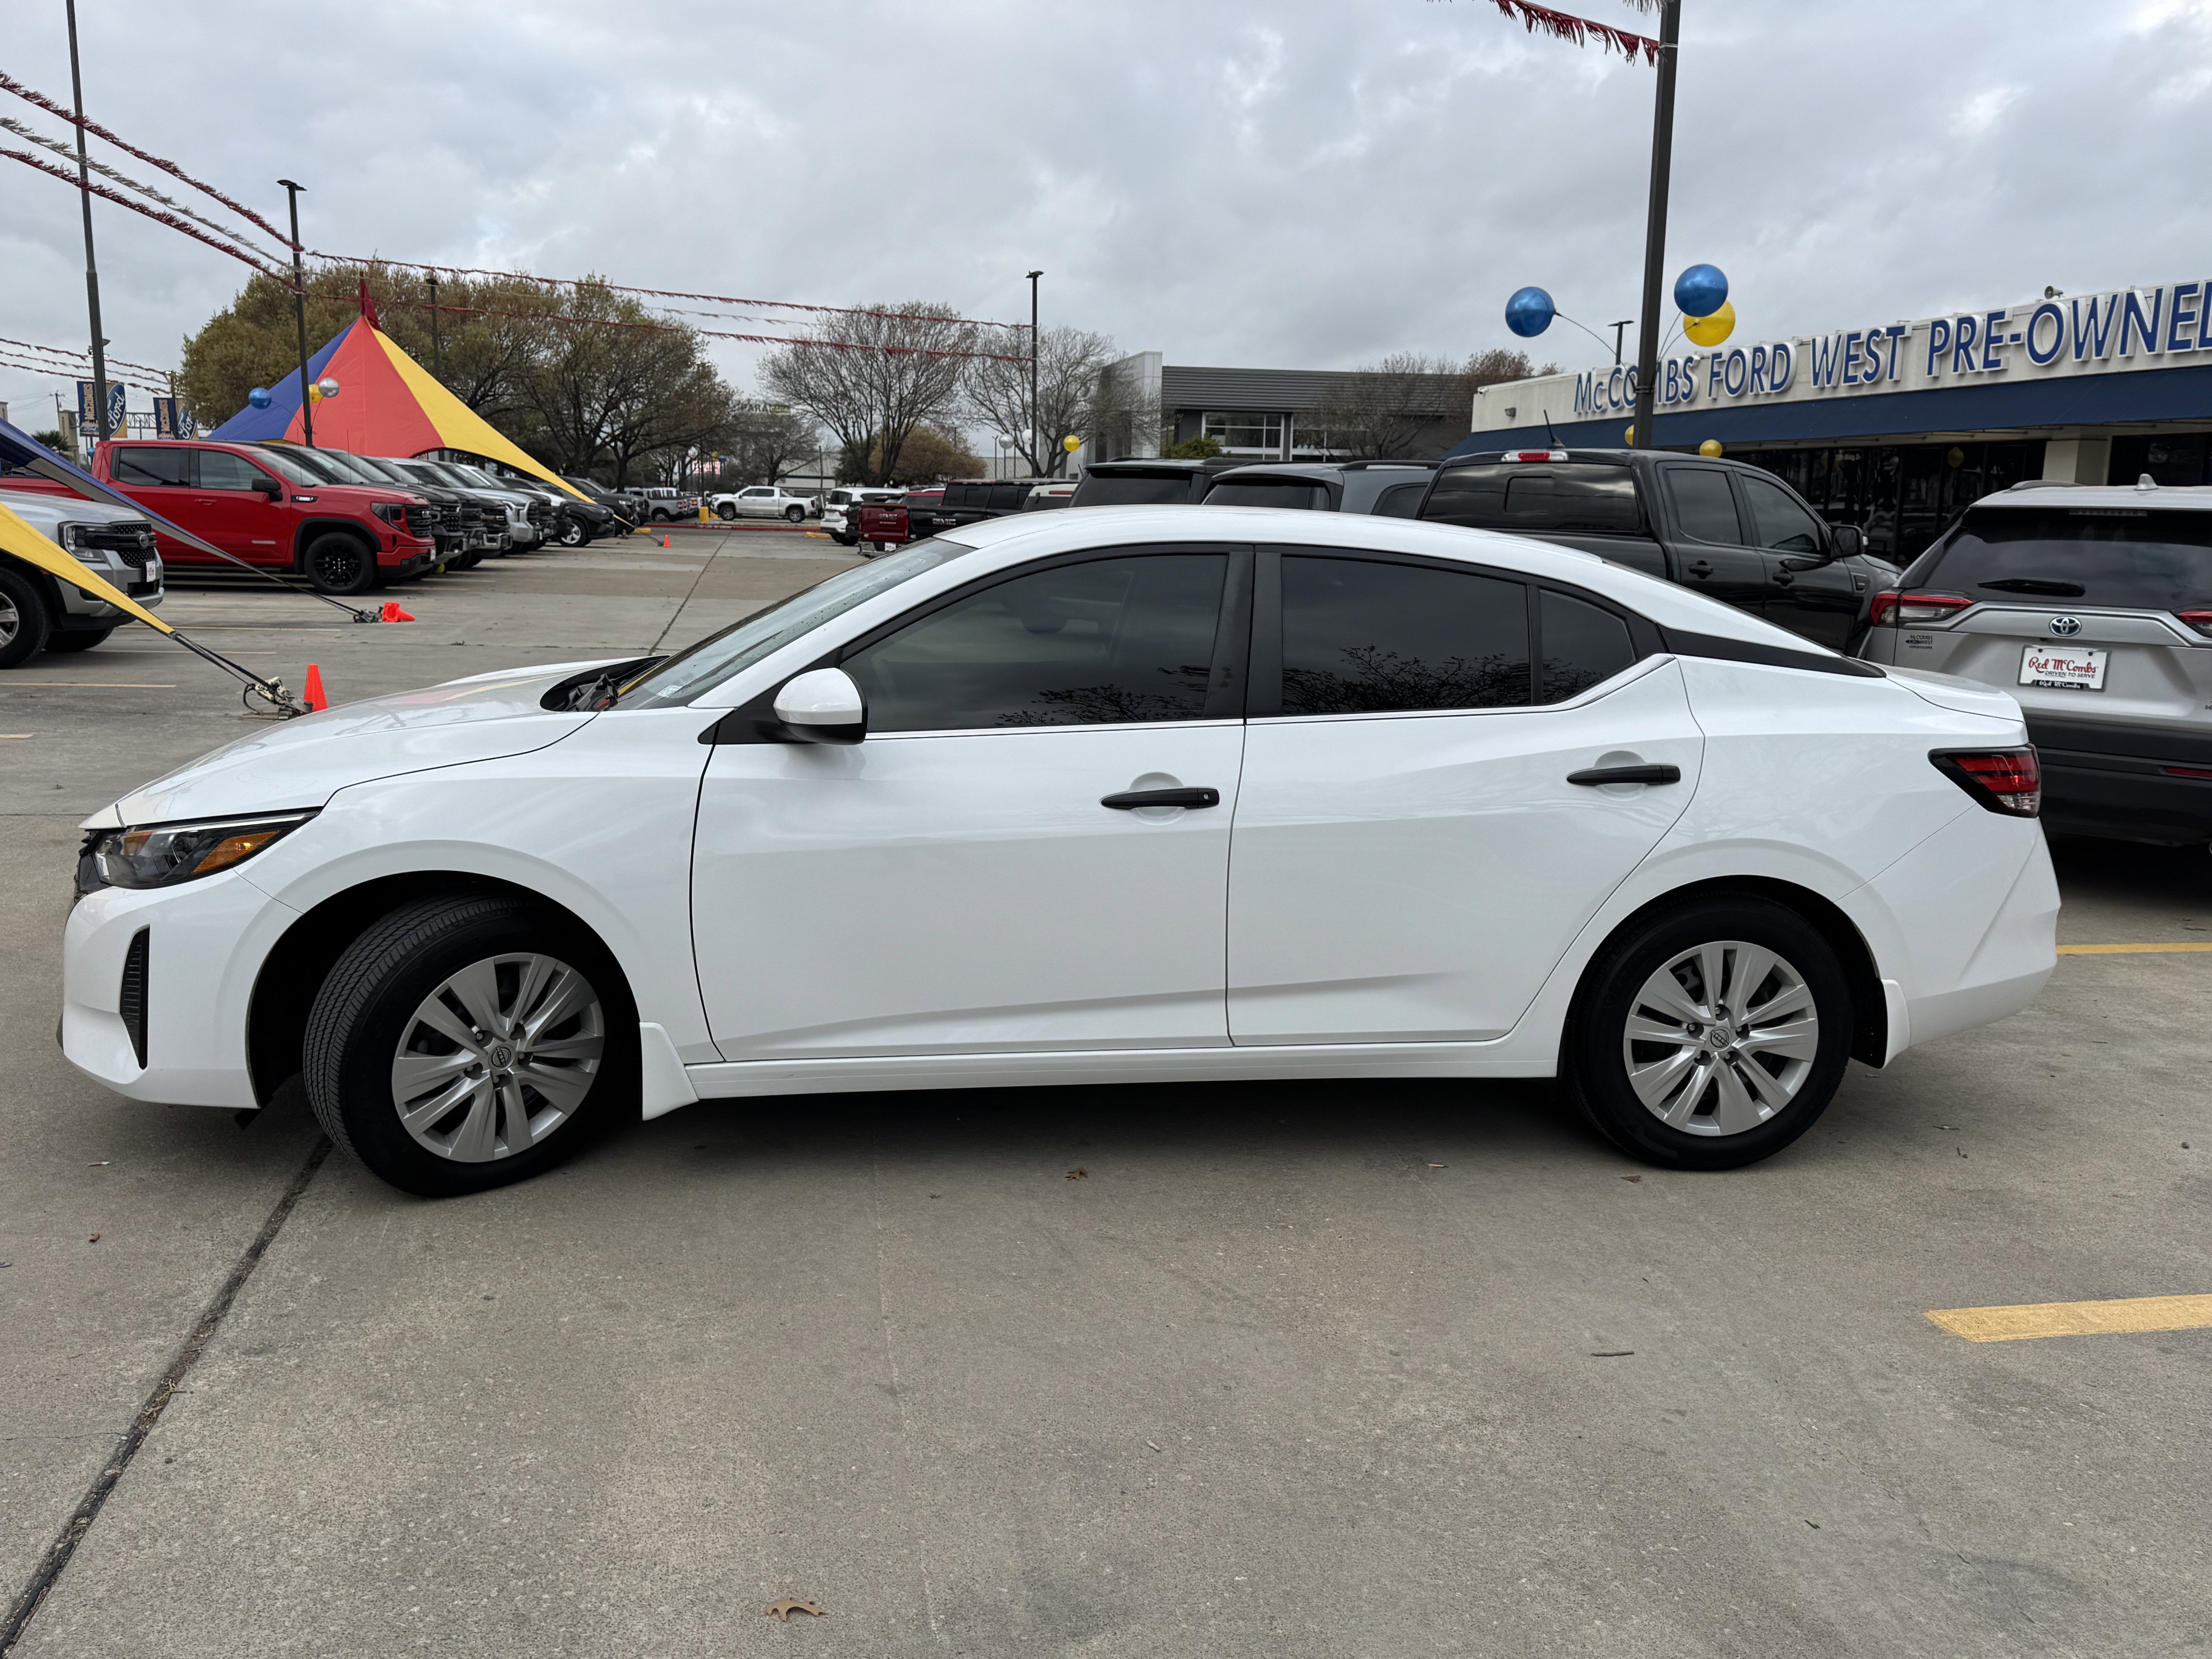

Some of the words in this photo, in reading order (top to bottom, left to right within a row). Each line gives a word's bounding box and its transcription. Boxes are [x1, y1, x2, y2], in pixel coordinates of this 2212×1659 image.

[1574, 355, 1698, 413] McCOBS
[1707, 343, 1795, 399] FORD
[1810, 324, 1908, 388] WEST
[107, 392, 125, 429] Ford
[2028, 656, 2049, 673] Red
[2051, 658, 2096, 673] McCombs
